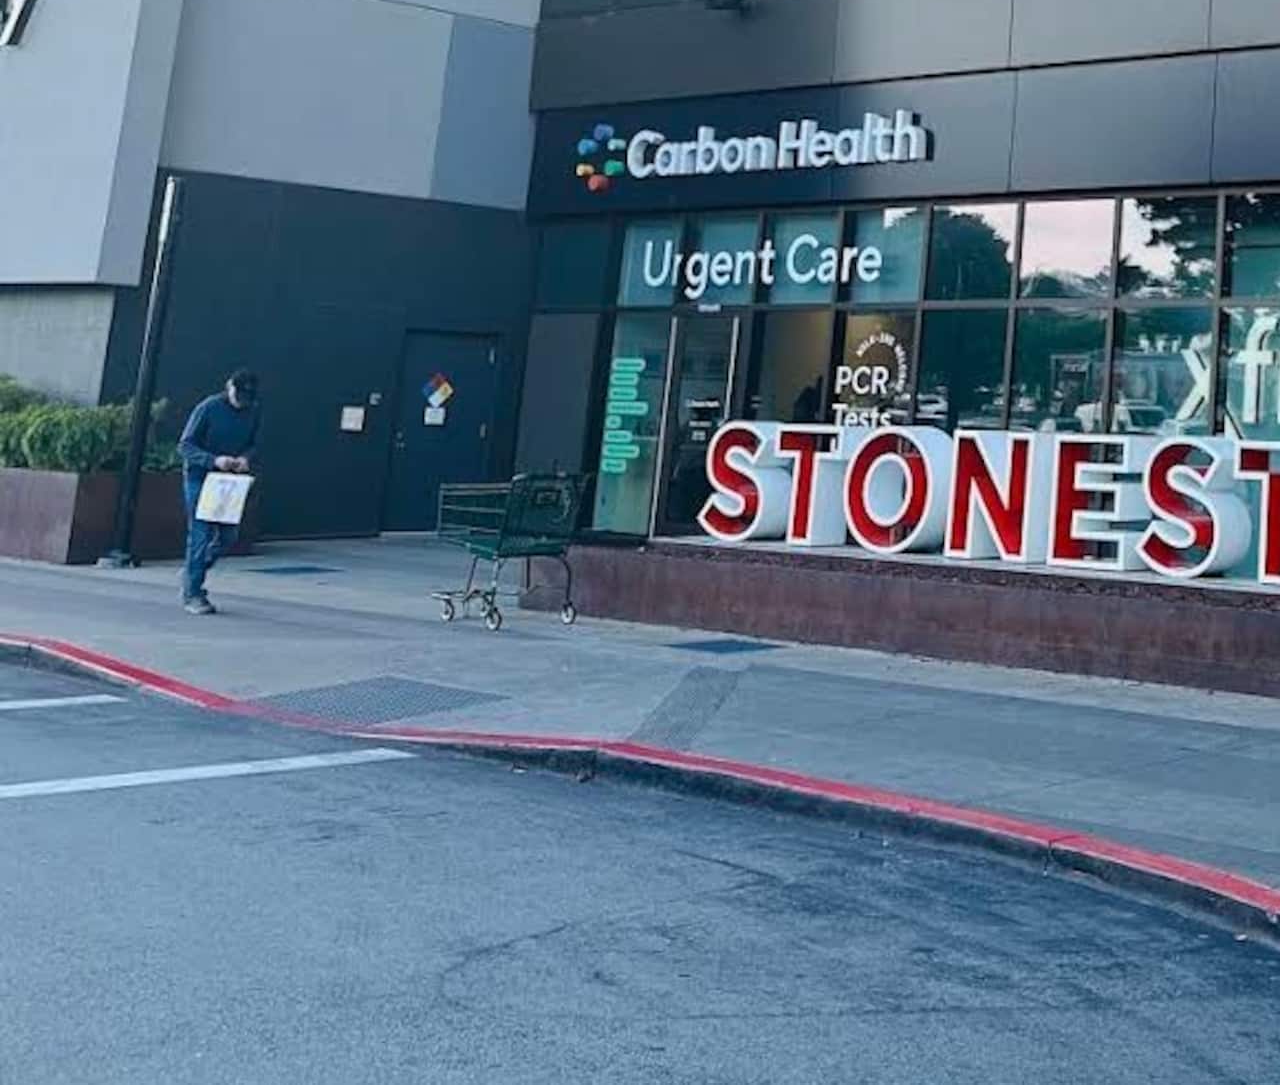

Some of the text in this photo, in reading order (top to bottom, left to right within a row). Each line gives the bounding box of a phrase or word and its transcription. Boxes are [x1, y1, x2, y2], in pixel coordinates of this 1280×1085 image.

[627, 109, 927, 179] Carbon Health
[643, 234, 883, 299] Urgent Care
[834, 365, 890, 395] PCR
[832, 403, 892, 429] Tests
